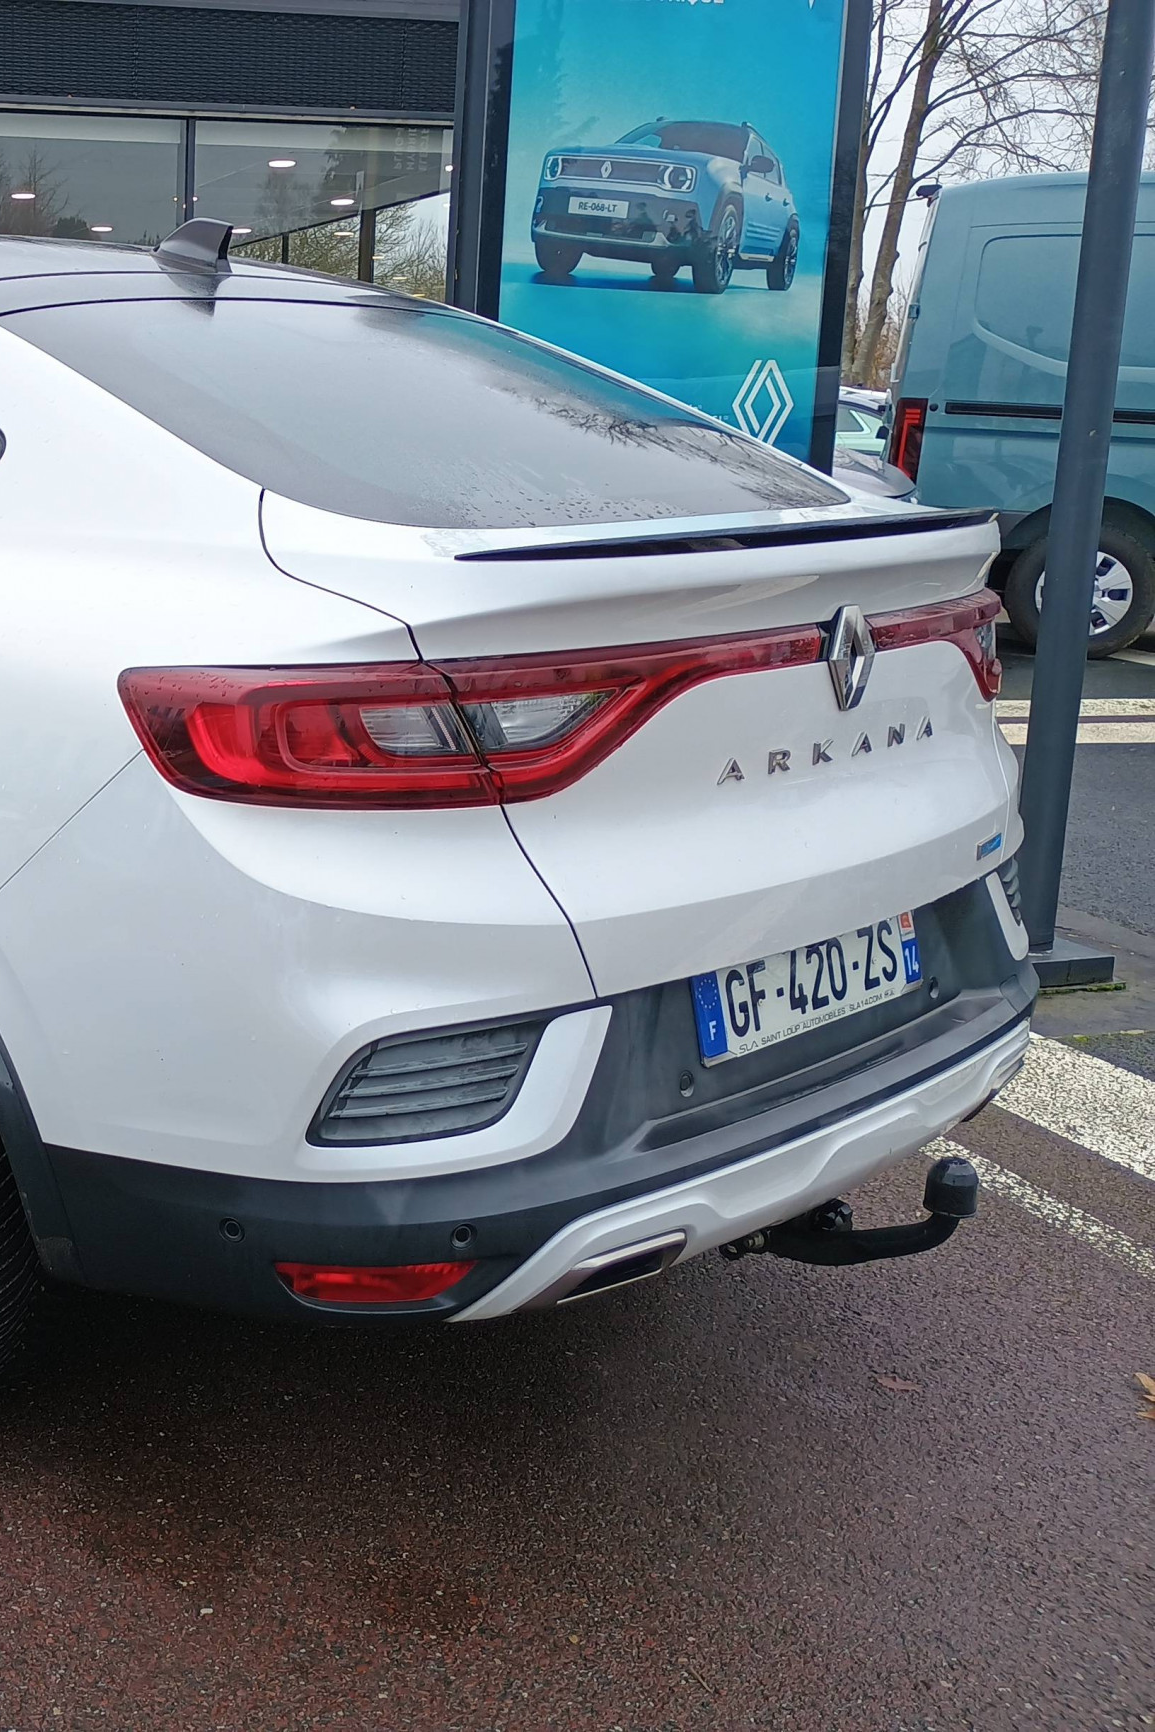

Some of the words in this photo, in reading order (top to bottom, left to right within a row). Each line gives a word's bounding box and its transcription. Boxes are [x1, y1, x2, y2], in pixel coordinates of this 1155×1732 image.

[577, 201, 618, 213] RE-068-LT
[717, 716, 934, 786] ARKANA
[904, 945, 920, 976] 14
[725, 919, 898, 1038] GF-420-ZS
[708, 1020, 717, 1041] F
[760, 1030, 782, 1046] SAINT
[782, 1023, 801, 1038] LOUP
[802, 1006, 846, 1031] AUTOMOBILES
